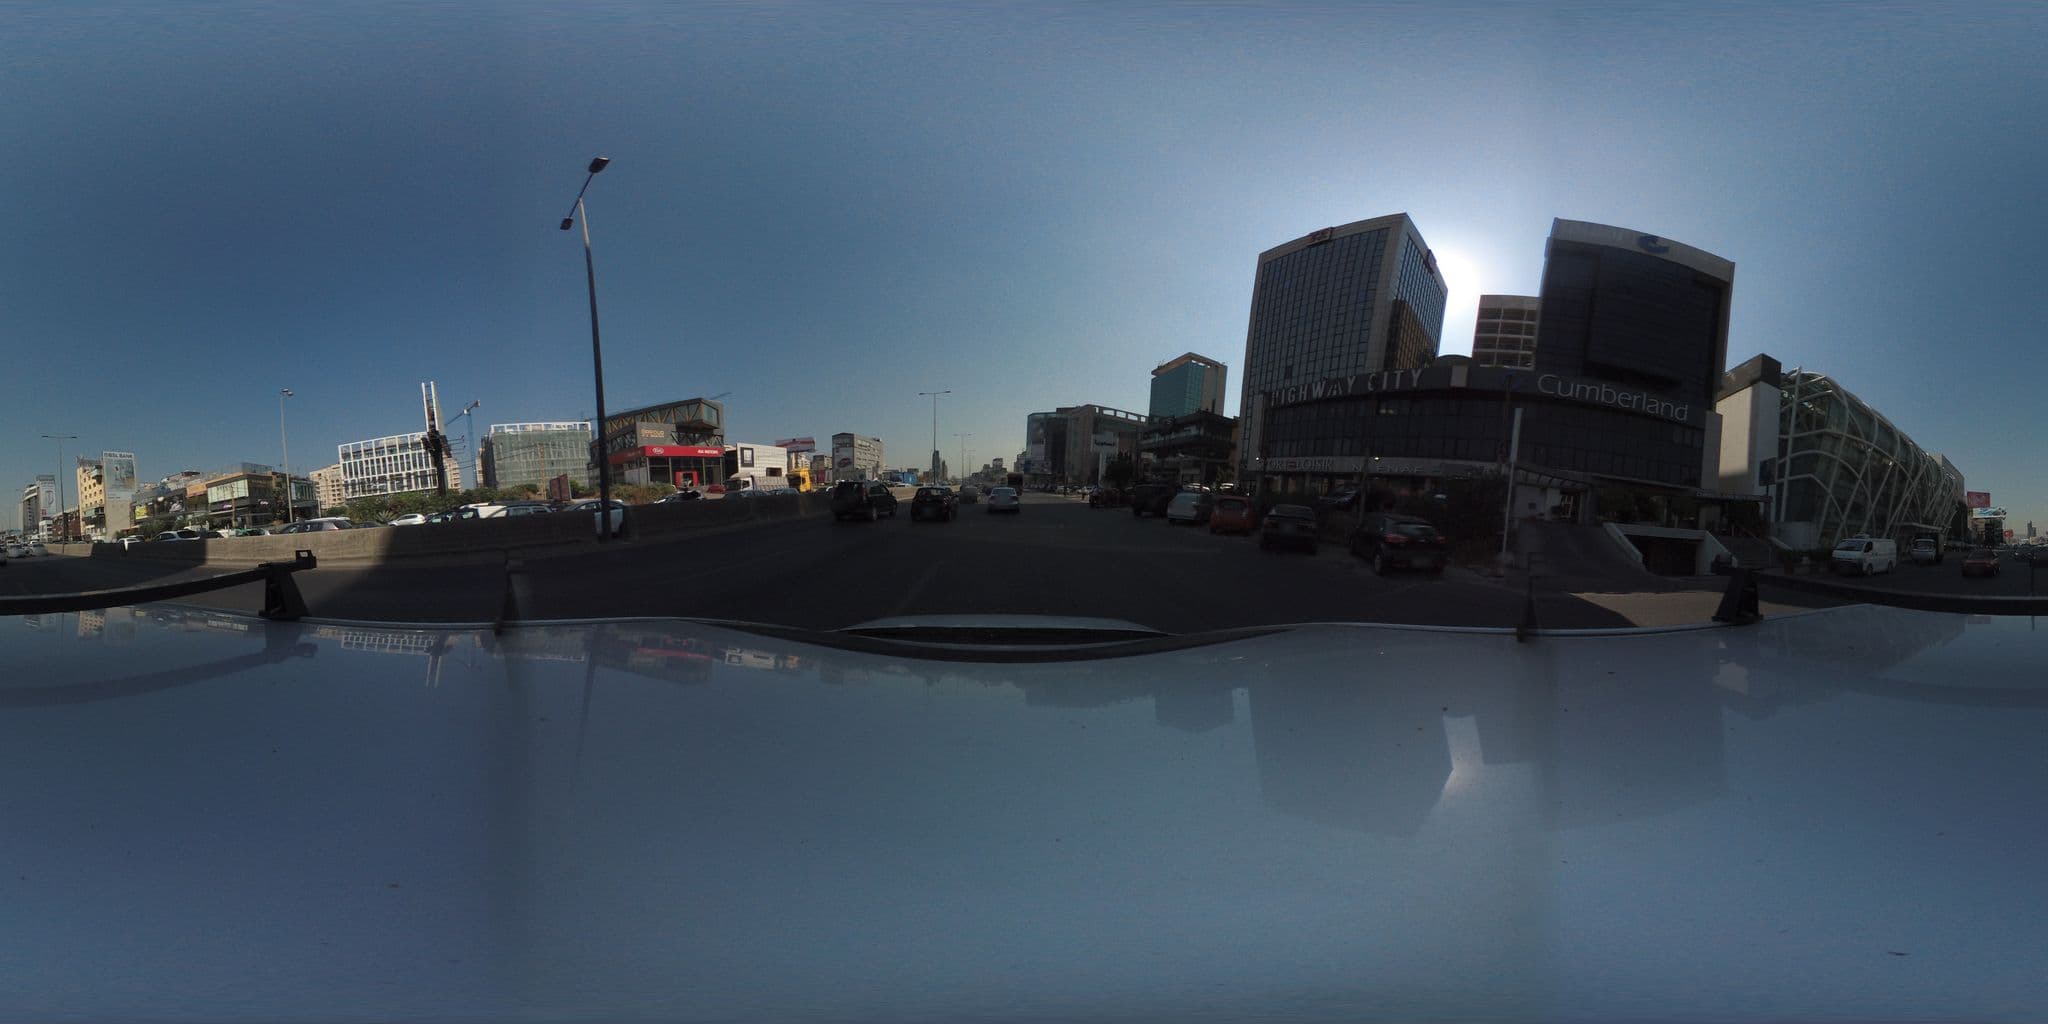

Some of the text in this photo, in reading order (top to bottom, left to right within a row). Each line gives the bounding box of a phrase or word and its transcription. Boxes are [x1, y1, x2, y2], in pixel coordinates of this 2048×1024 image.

[1271, 368, 1423, 407] HIGHWAY CITY
[1537, 374, 1689, 422] Cumberland
